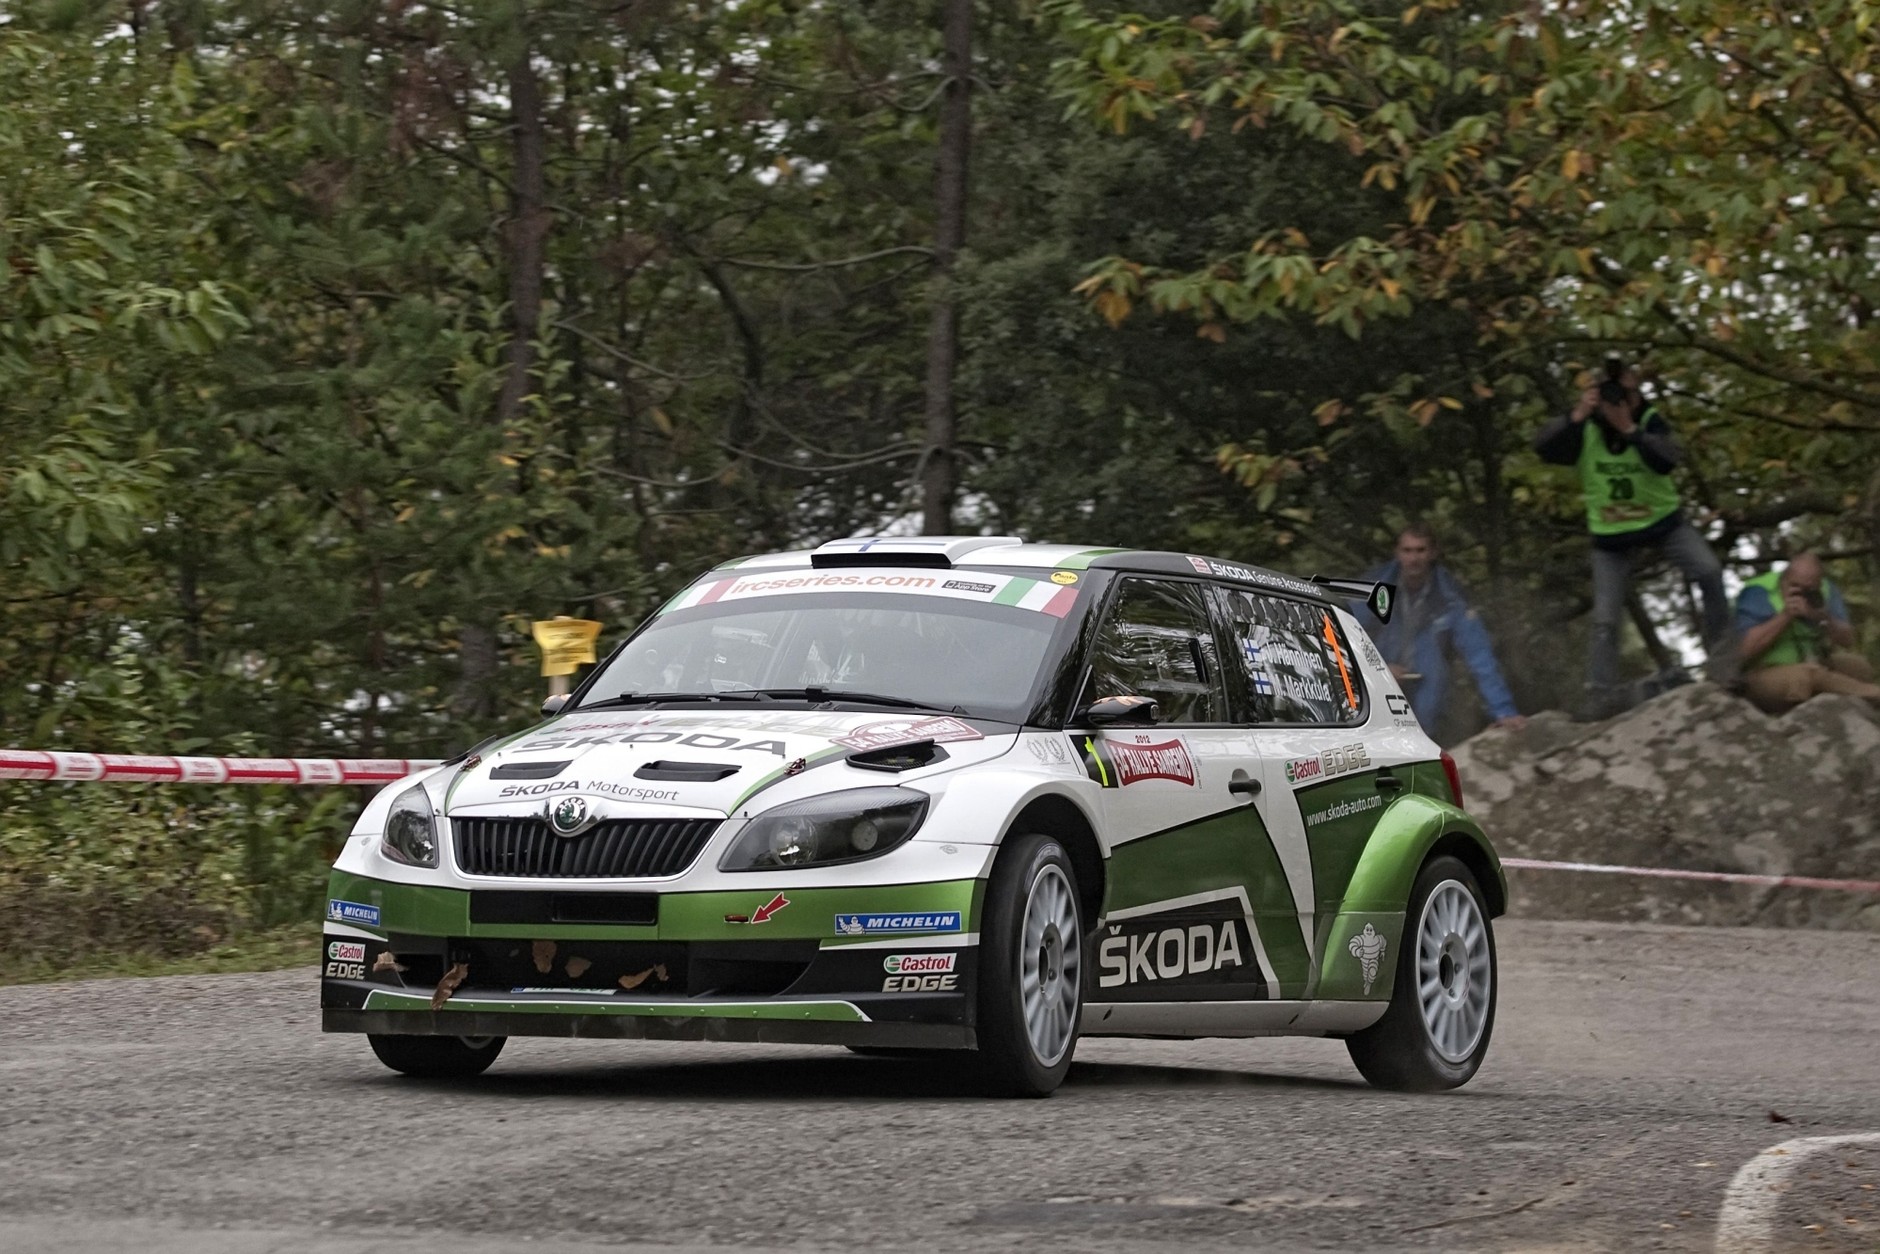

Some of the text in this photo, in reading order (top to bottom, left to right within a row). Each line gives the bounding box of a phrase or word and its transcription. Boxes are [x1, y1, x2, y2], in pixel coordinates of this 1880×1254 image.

[1210, 561, 1256, 582] ŠKODA
[731, 573, 936, 594] ircseries.com
[511, 732, 786, 756] ŠKODA
[1294, 742, 1371, 780] Castrol EDGE
[499, 780, 680, 801] ŠKODA Motorsport
[1307, 794, 1382, 827] www.skoda-auto.com
[344, 906, 378, 921] MICHELIN
[867, 915, 955, 928] MICHELIN
[338, 944, 364, 960] Castrol
[1100, 920, 1243, 988] ŠKODA
[325, 962, 366, 980] EDGE
[901, 955, 951, 971] Castrol
[882, 974, 960, 993] EDGE
